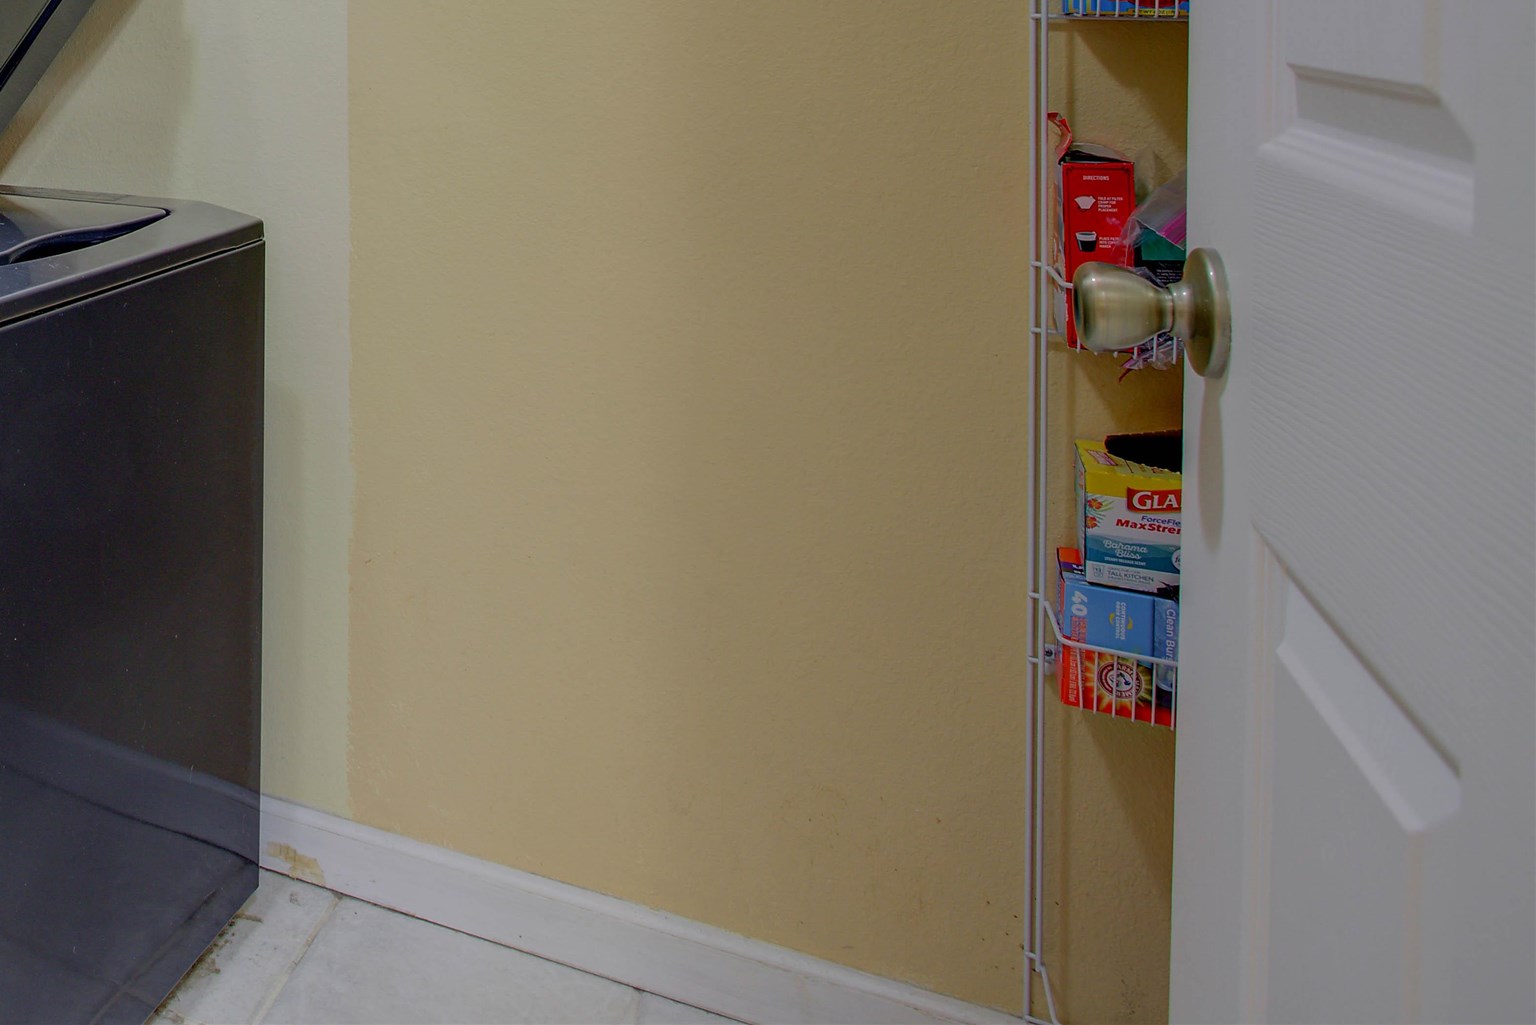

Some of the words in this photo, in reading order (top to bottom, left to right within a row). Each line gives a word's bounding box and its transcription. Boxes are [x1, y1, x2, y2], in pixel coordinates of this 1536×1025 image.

[1132, 491, 1179, 510] GLA
[1141, 515, 1181, 527] ForceFle
[1103, 539, 1148, 553] Bahama
[1115, 549, 1142, 560] Bliss
[1107, 569, 1123, 578] TALL
[1123, 572, 1155, 583] KITCHEN
[1071, 590, 1088, 617] 40
[1165, 608, 1176, 637] Clean
[1165, 640, 1176, 661] Bur
